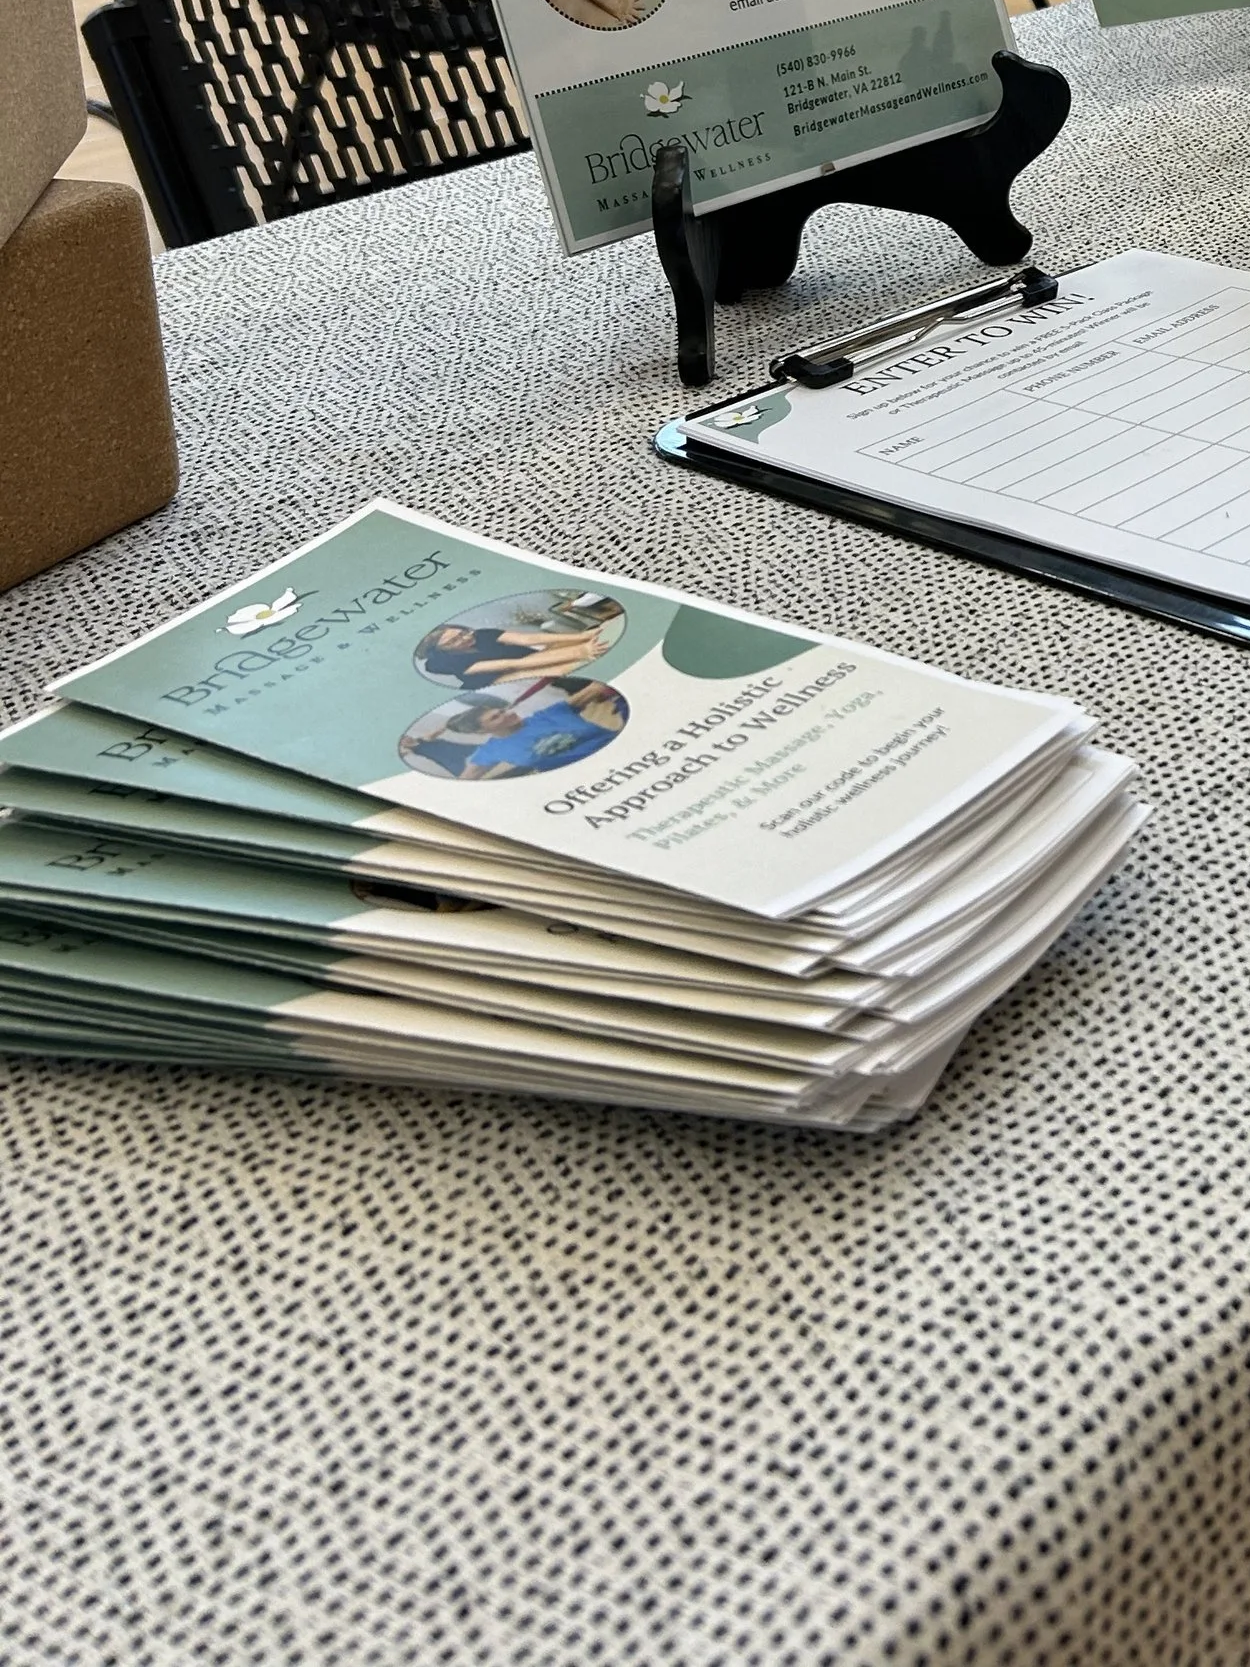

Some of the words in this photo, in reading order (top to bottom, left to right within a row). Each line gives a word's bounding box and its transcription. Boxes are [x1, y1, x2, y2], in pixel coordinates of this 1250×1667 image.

[776, 58, 805, 77] (540)
[806, 45, 857, 68] 830-9966
[784, 78, 815, 98] 121-B
[817, 76, 829, 90] N.
[831, 69, 856, 85] Main
[858, 65, 872, 77] St.
[788, 91, 852, 114] Bridgewater,
[853, 83, 870, 95] VA
[871, 72, 902, 91] 22812
[793, 70, 989, 137] BridgewaterMassageandWellness.com
[597, 189, 650, 214] MASSA
[694, 152, 772, 183] WELLNESS
[840, 346, 967, 395] ENTER
[954, 325, 1012, 347] TO
[1005, 293, 1095, 324] WIN!
[900, 381, 965, 409] Therapeutic
[961, 362, 1007, 383] Massage
[1085, 314, 1121, 330] Winner
[1132, 321, 1172, 345] EMAIL
[1169, 303, 1221, 330] ADDRESS
[846, 407, 873, 419] Sign
[887, 388, 921, 403] below
[939, 370, 961, 382] your
[963, 355, 998, 372] chance
[1034, 328, 1063, 342] FREE
[1023, 371, 1071, 392] PHONE
[1067, 349, 1121, 373] NUMBER
[879, 435, 925, 456] NAME
[160, 549, 453, 707] Bridgewater
[203, 656, 325, 716] MASSAGE
[337, 642, 353, 651] &
[358, 568, 483, 635] WELLNESS
[543, 751, 670, 818] Offering
[667, 737, 687, 753] a
[683, 673, 785, 739] Holistic
[583, 751, 719, 830] Approach
[713, 733, 749, 754] to
[743, 659, 858, 732] Wellness
[631, 774, 751, 842] Therapeutic
[745, 723, 836, 777] Massage,
[824, 689, 884, 722] Yoga,
[760, 805, 804, 832] Scan
[799, 789, 826, 809] our
[825, 765, 863, 794] code
[857, 752, 879, 767] to
[873, 728, 918, 757] begin
[914, 706, 946, 730] your
[780, 802, 840, 839] holistic
[838, 764, 898, 806] wellness
[896, 724, 951, 768] journey!
[653, 810, 737, 850] Pilates,
[731, 795, 757, 809] &
[750, 763, 808, 797] More
